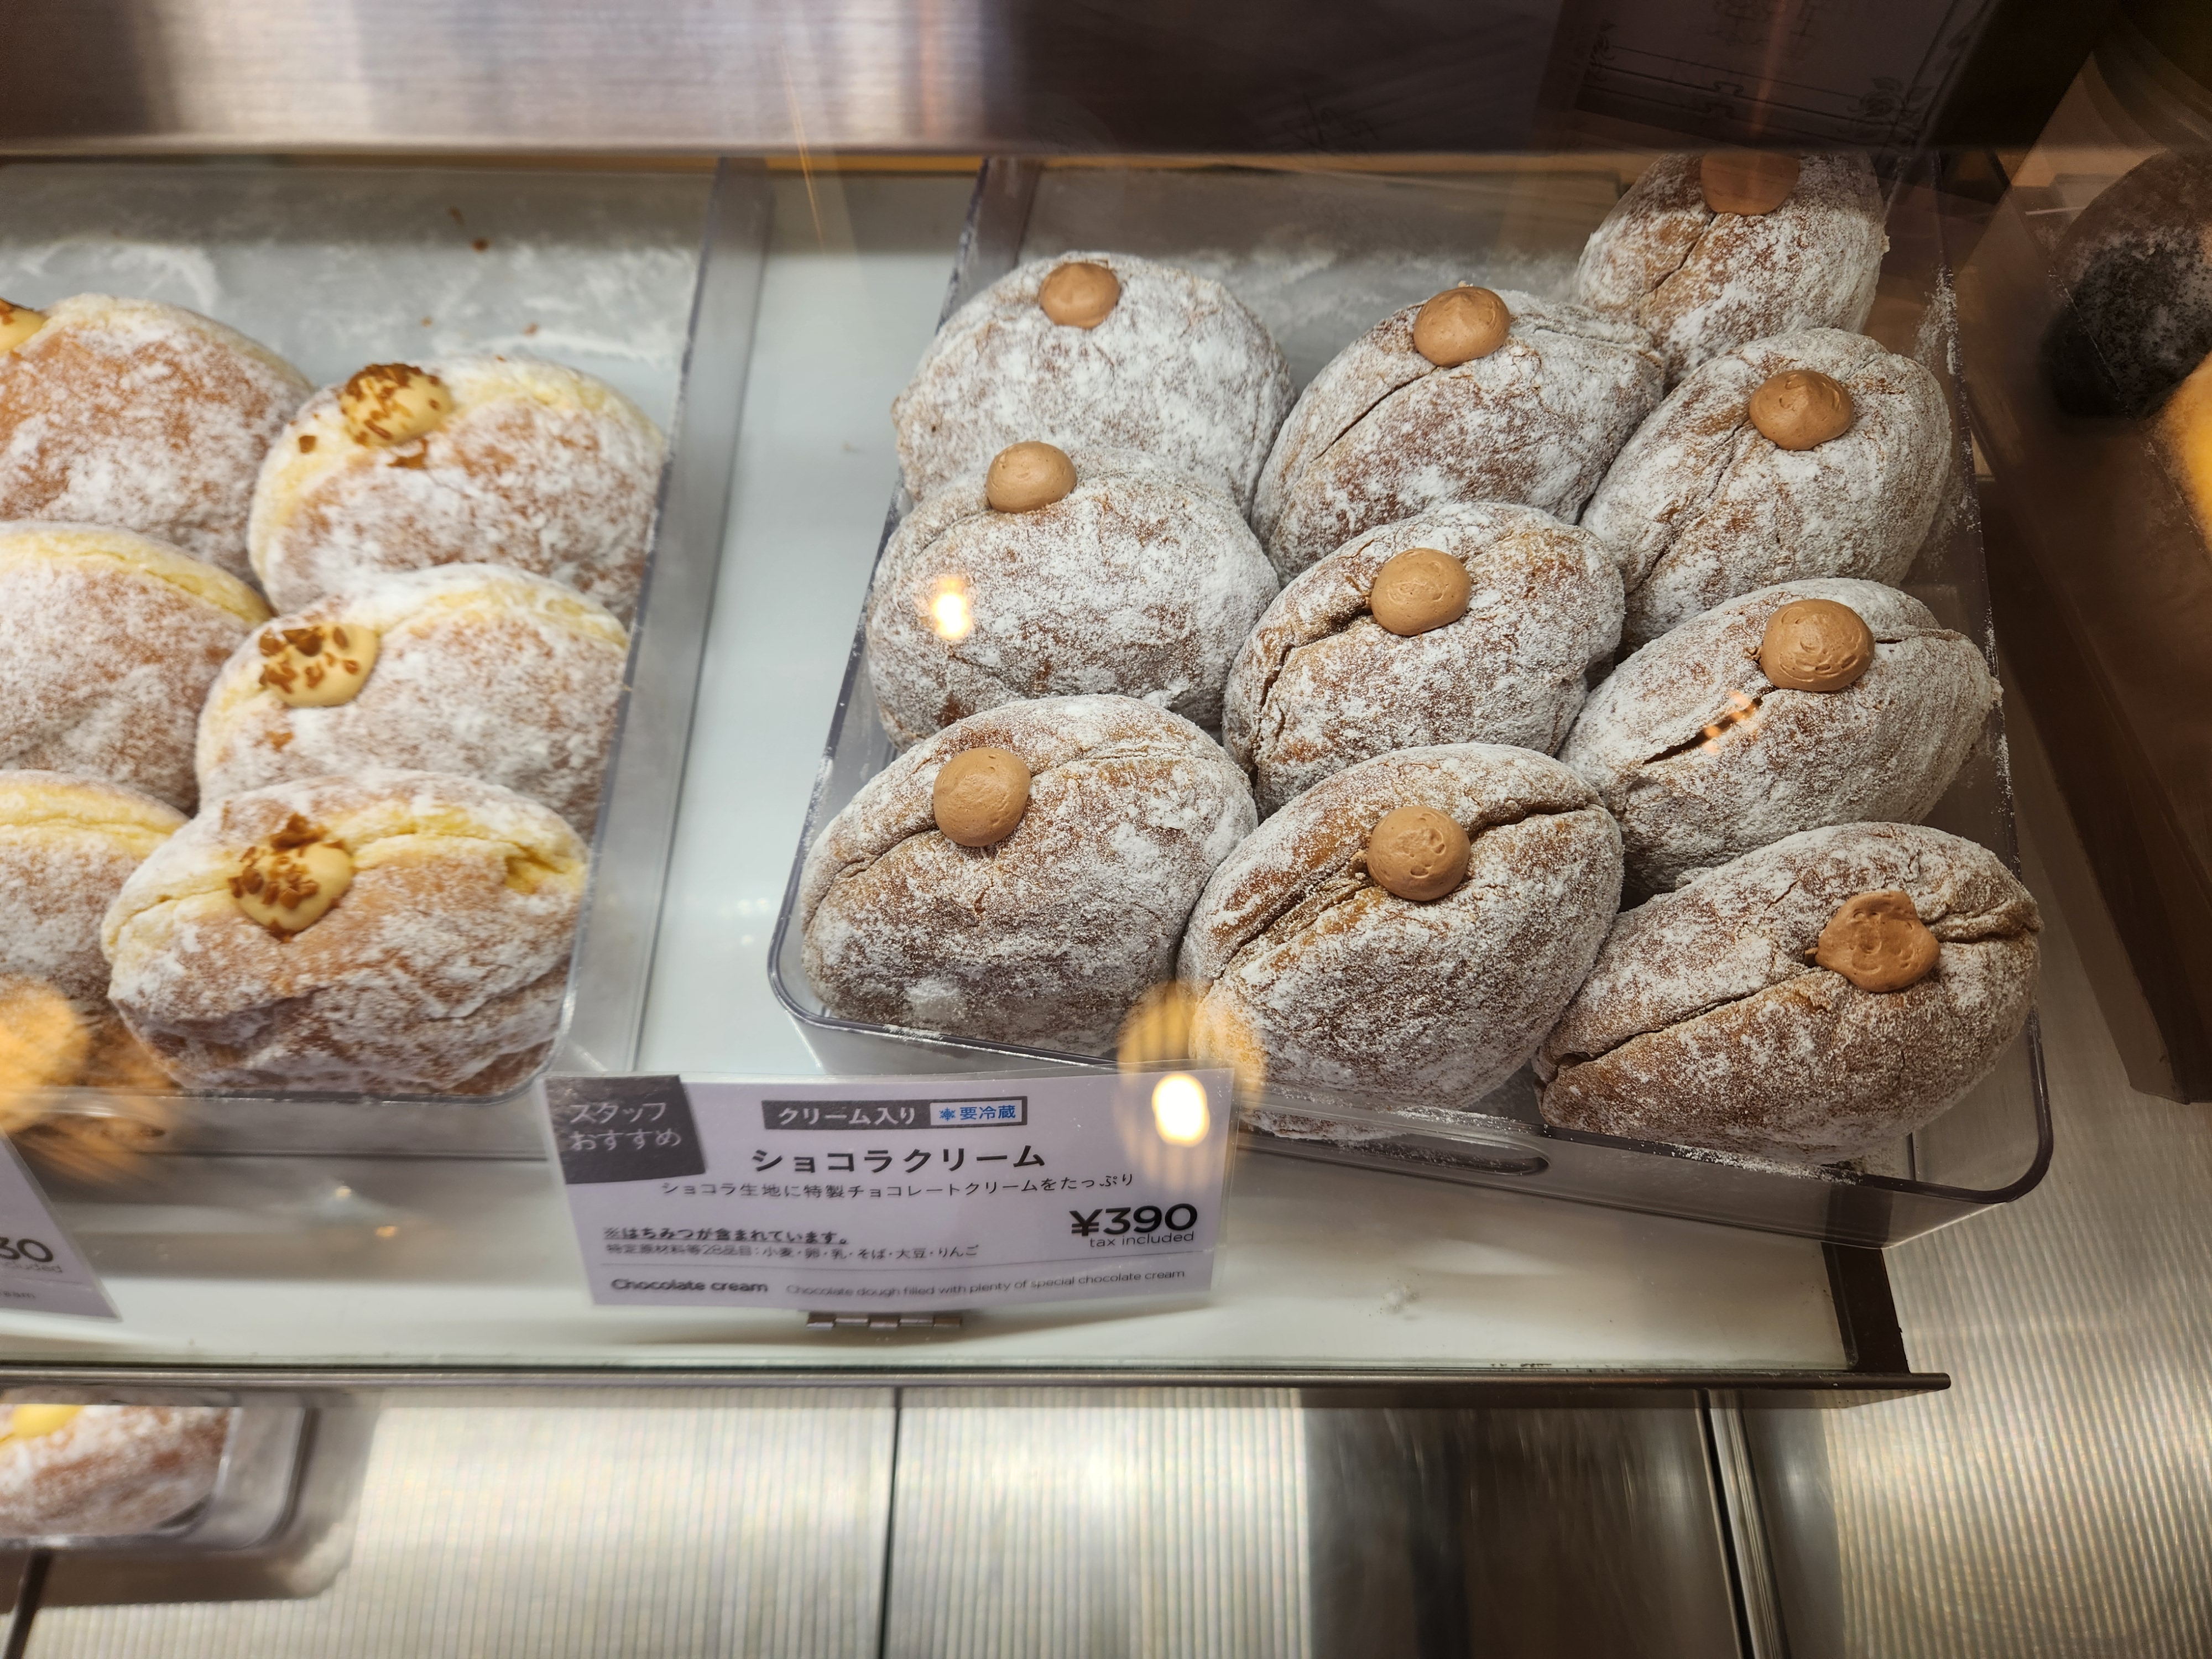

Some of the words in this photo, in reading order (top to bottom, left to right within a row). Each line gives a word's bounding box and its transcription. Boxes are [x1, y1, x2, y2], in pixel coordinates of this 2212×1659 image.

[570, 1102, 666, 1125] スタッフ
[778, 1106, 915, 1125] クリーム入り
[959, 1104, 1016, 1120] 要冷蔵
[570, 1128, 682, 1151] おすすめ
[752, 1145, 1045, 1173] ショコラクリーム
[662, 1173, 1133, 1199] ショコラ生地に特製チョコレートクリームをたっぷり
[1069, 1203, 1198, 1237] ¥390
[1089, 1237, 1116, 1248] tax
[1121, 1231, 1194, 1246] included
[611, 1278, 706, 1290] Chocolate
[711, 1281, 769, 1292] cream
[904, 1284, 935, 1295] filled
[940, 1282, 967, 1294] with
[970, 1281, 1011, 1294] plenty
[1014, 1279, 1027, 1289] of
[1031, 1276, 1074, 1289] special
[1078, 1272, 1141, 1285] chocolate
[1145, 1270, 1185, 1280] cream
